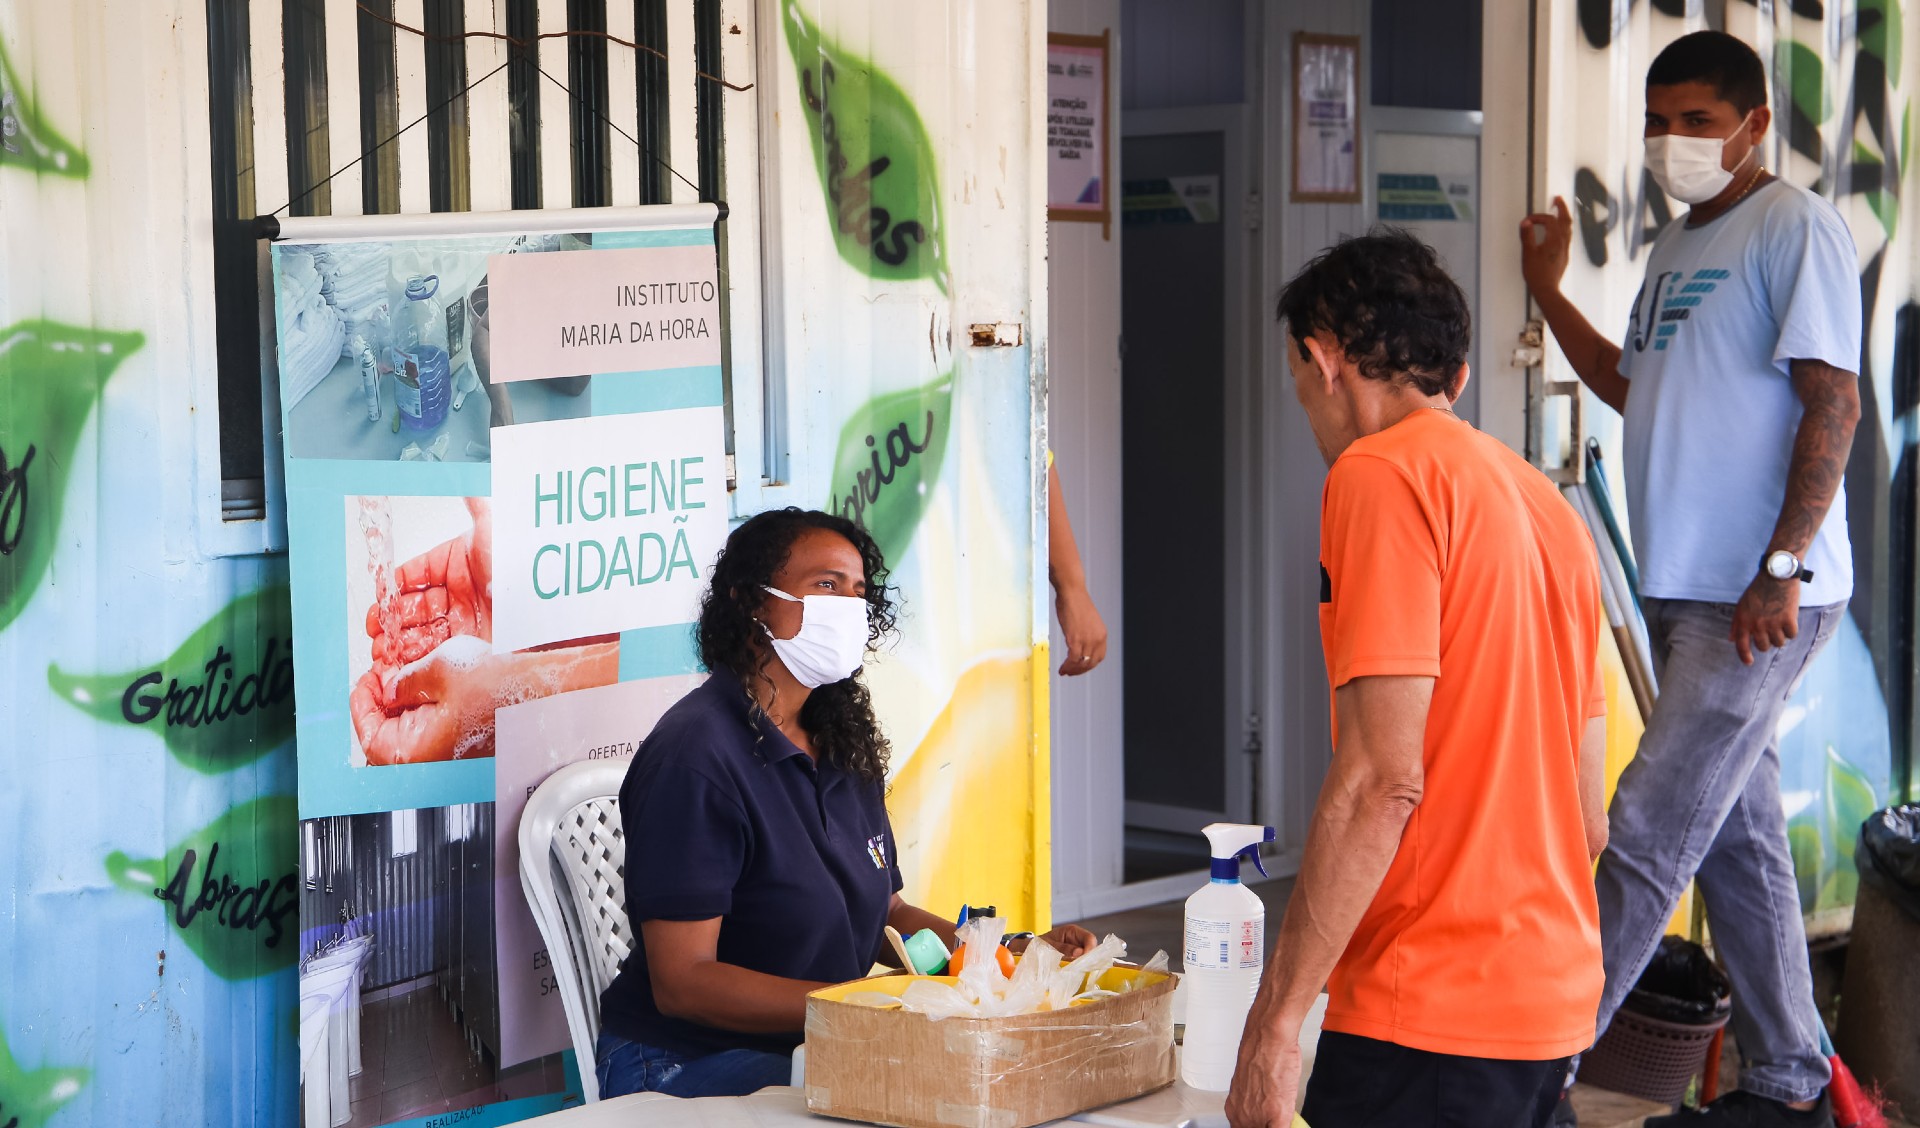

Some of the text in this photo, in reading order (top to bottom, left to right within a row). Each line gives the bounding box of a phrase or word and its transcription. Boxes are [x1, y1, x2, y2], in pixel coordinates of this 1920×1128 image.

[617, 281, 714, 307] INSTITUTO
[561, 317, 709, 348] MARIA DA HORA
[535, 456, 706, 528] HIGIENE
[532, 514, 699, 600] CIDADÃ
[588, 742, 633, 760] OFERTA
[533, 949, 552, 970] ES
